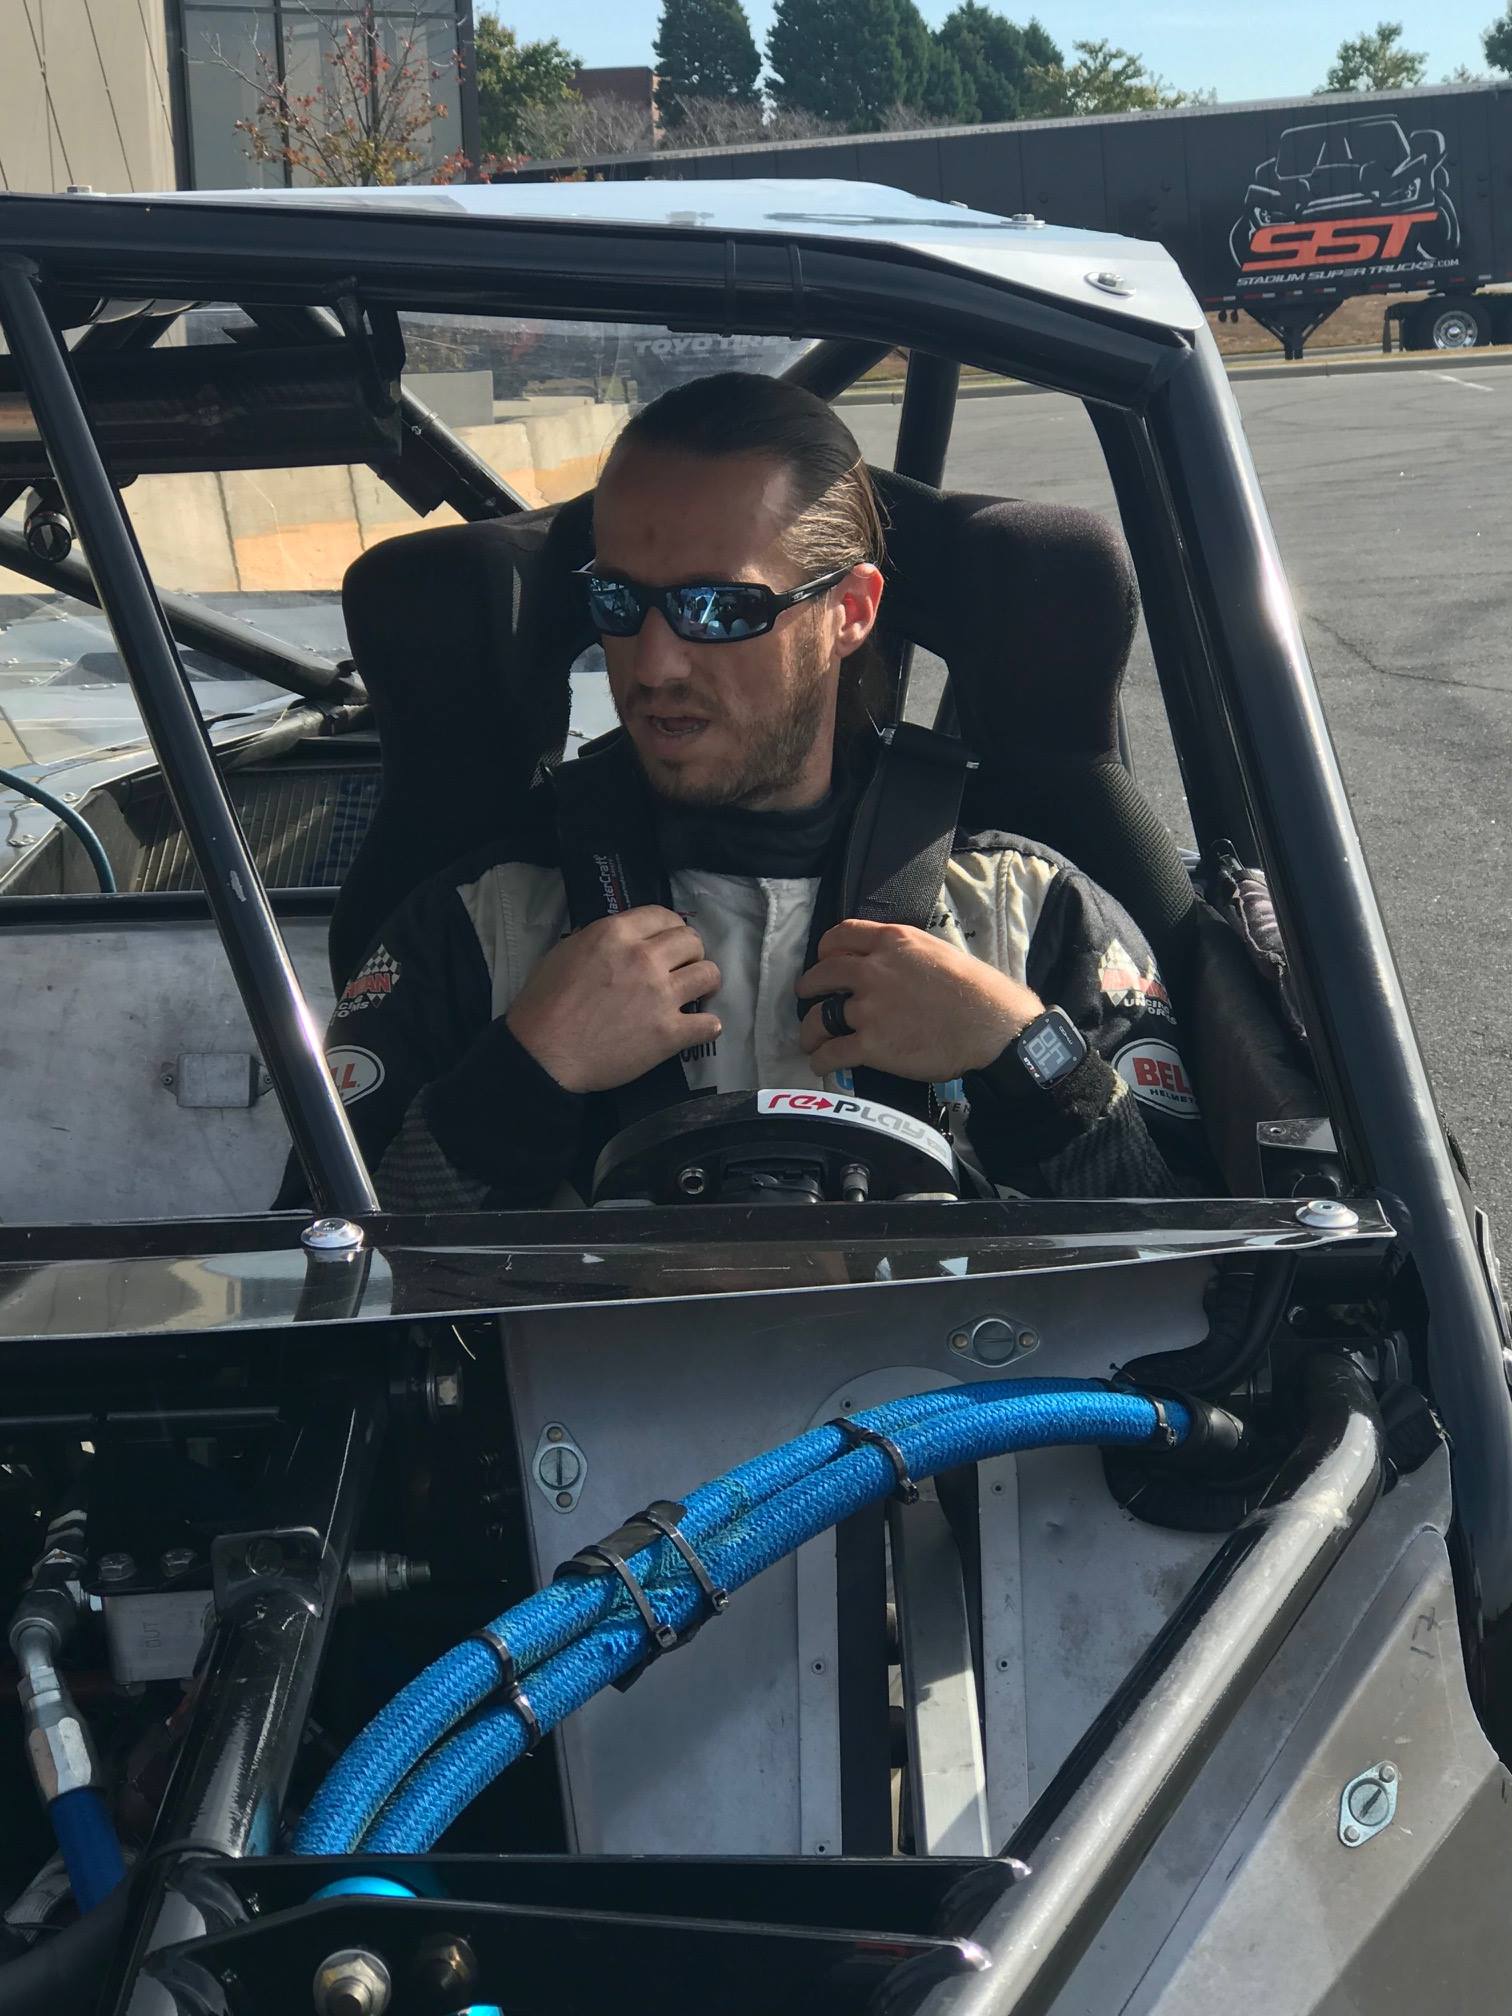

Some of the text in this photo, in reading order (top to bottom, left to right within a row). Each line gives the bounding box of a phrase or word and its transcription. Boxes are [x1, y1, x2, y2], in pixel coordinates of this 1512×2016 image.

[1236, 273, 1306, 287] STADIUM
[1307, 267, 1366, 281] SUPER
[634, 336, 713, 355] TOYO
[1133, 1057, 1193, 1094] BEL
